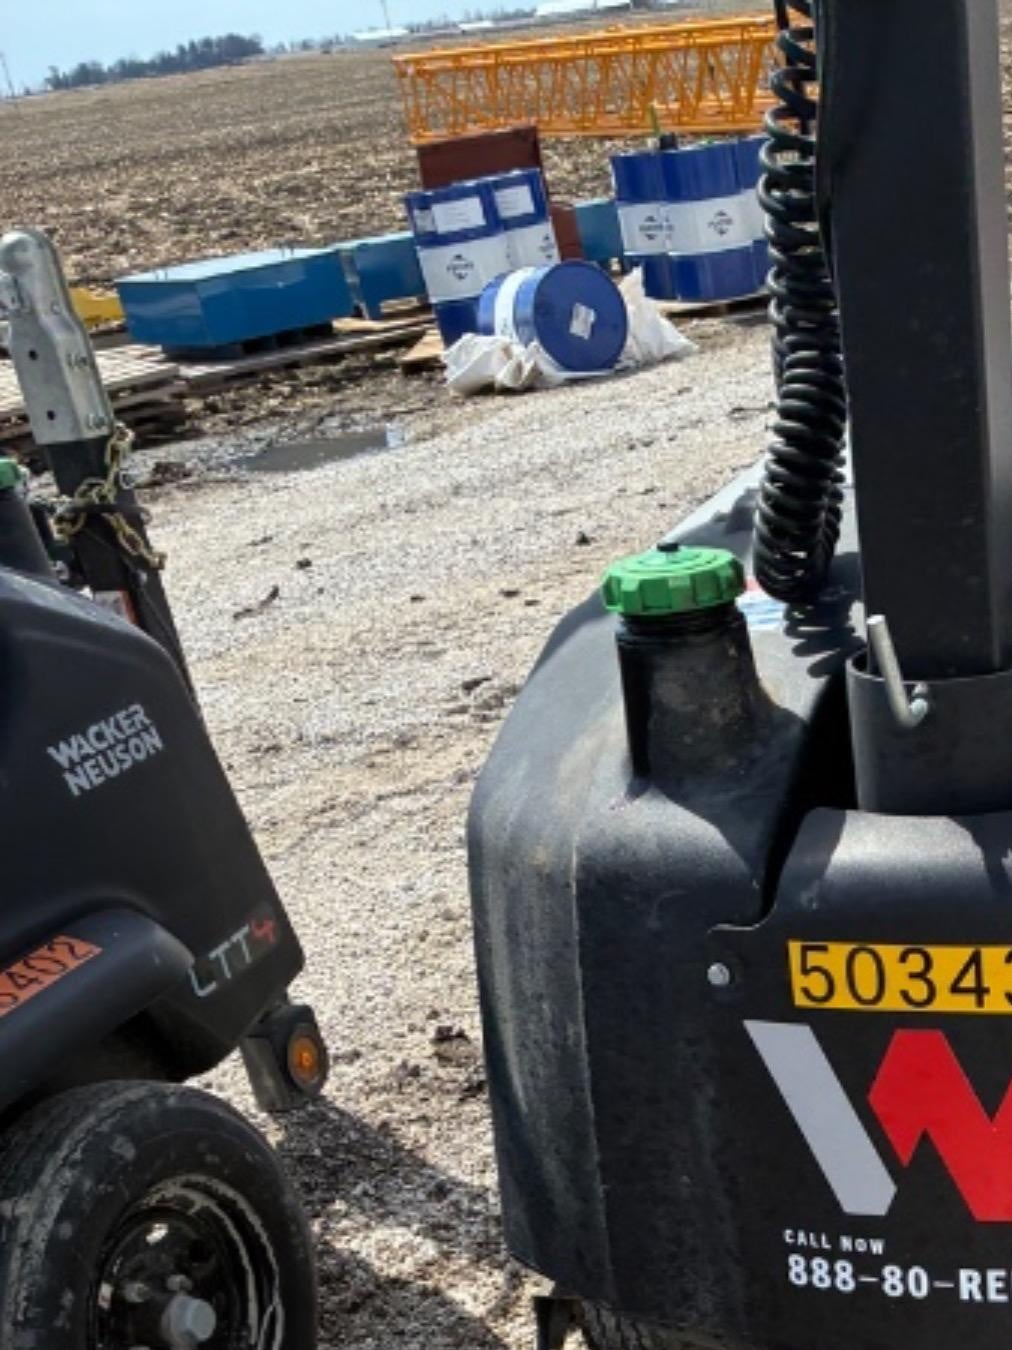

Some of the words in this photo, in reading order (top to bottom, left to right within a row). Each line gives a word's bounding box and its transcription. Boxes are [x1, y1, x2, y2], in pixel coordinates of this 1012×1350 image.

[47, 704, 153, 767] WACKER
[63, 727, 163, 796] NEUSON
[784, 1229, 831, 1249] CALL
[840, 1235, 885, 1255] NOW
